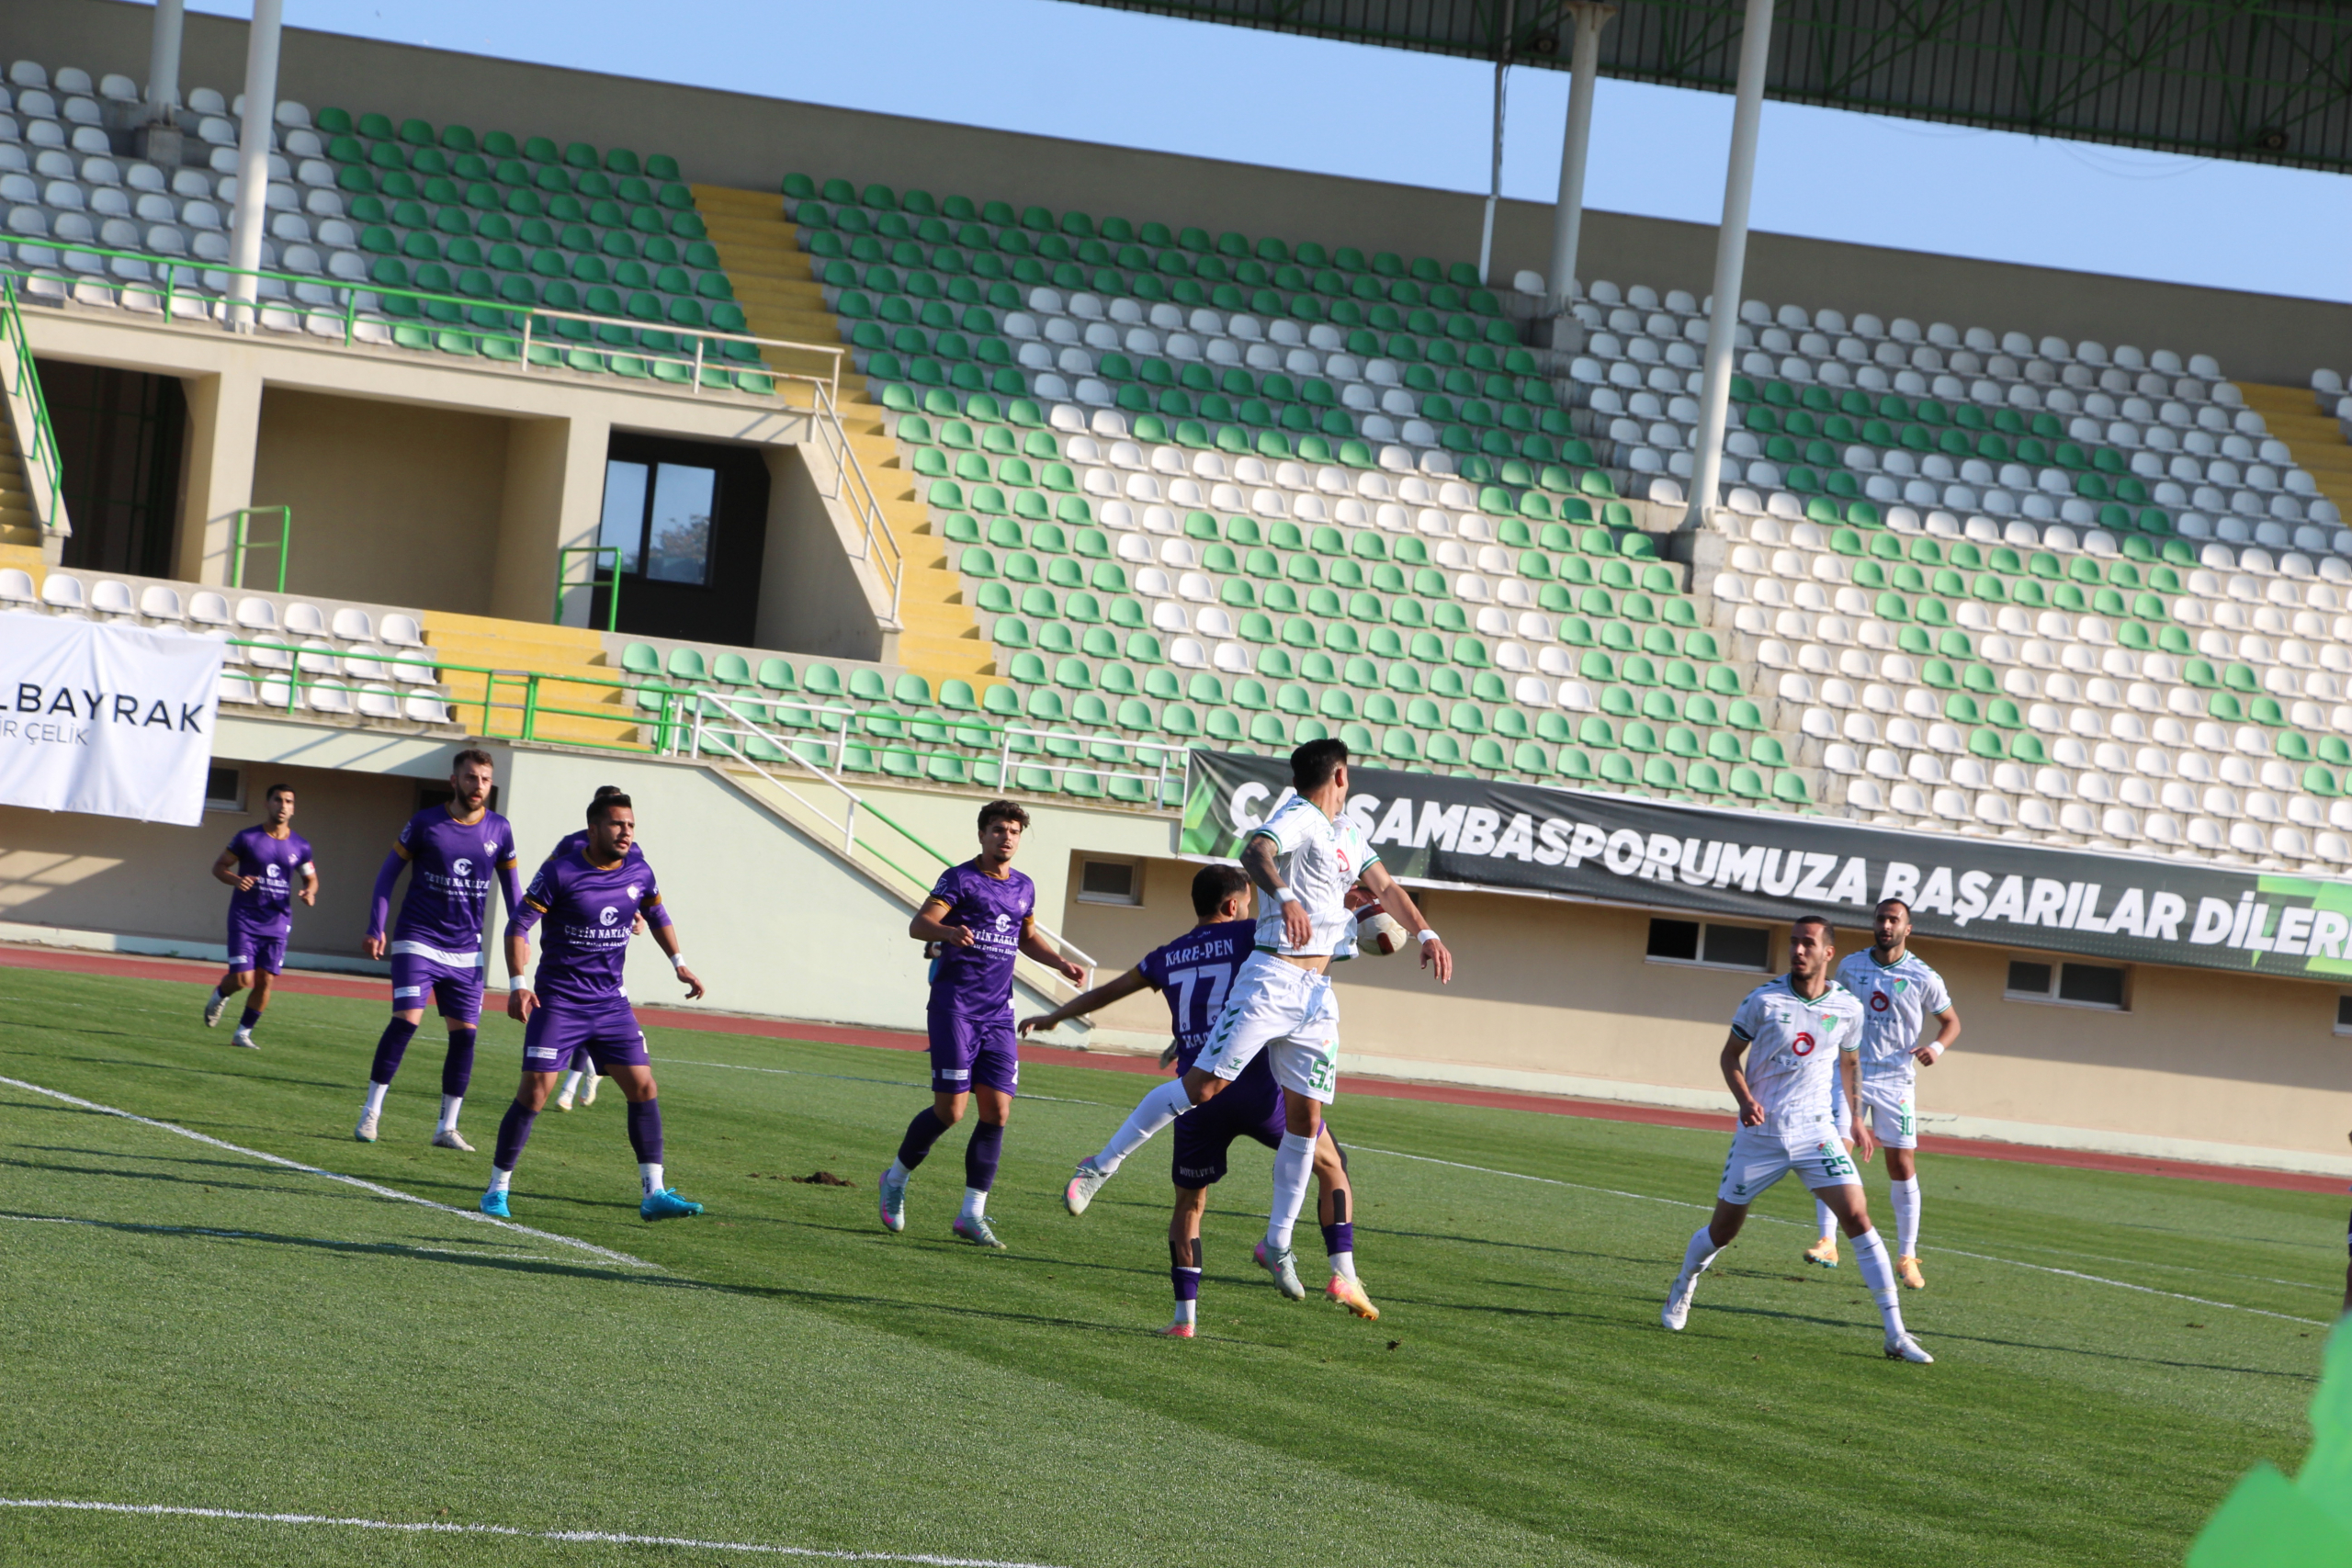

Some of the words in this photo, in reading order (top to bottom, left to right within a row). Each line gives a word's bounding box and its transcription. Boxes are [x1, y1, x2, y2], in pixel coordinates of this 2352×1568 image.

[25, 722, 90, 746] ÇELİK
[1878, 861, 2187, 942] BAŞARILAR
[2188, 890, 2352, 961] DİLER
[1165, 938, 1234, 967] KARE-PEN
[1168, 962, 1232, 1033] 77
[1308, 1057, 1335, 1093] 53
[1899, 1115, 1914, 1136] 10
[1821, 1155, 1854, 1177] 25
